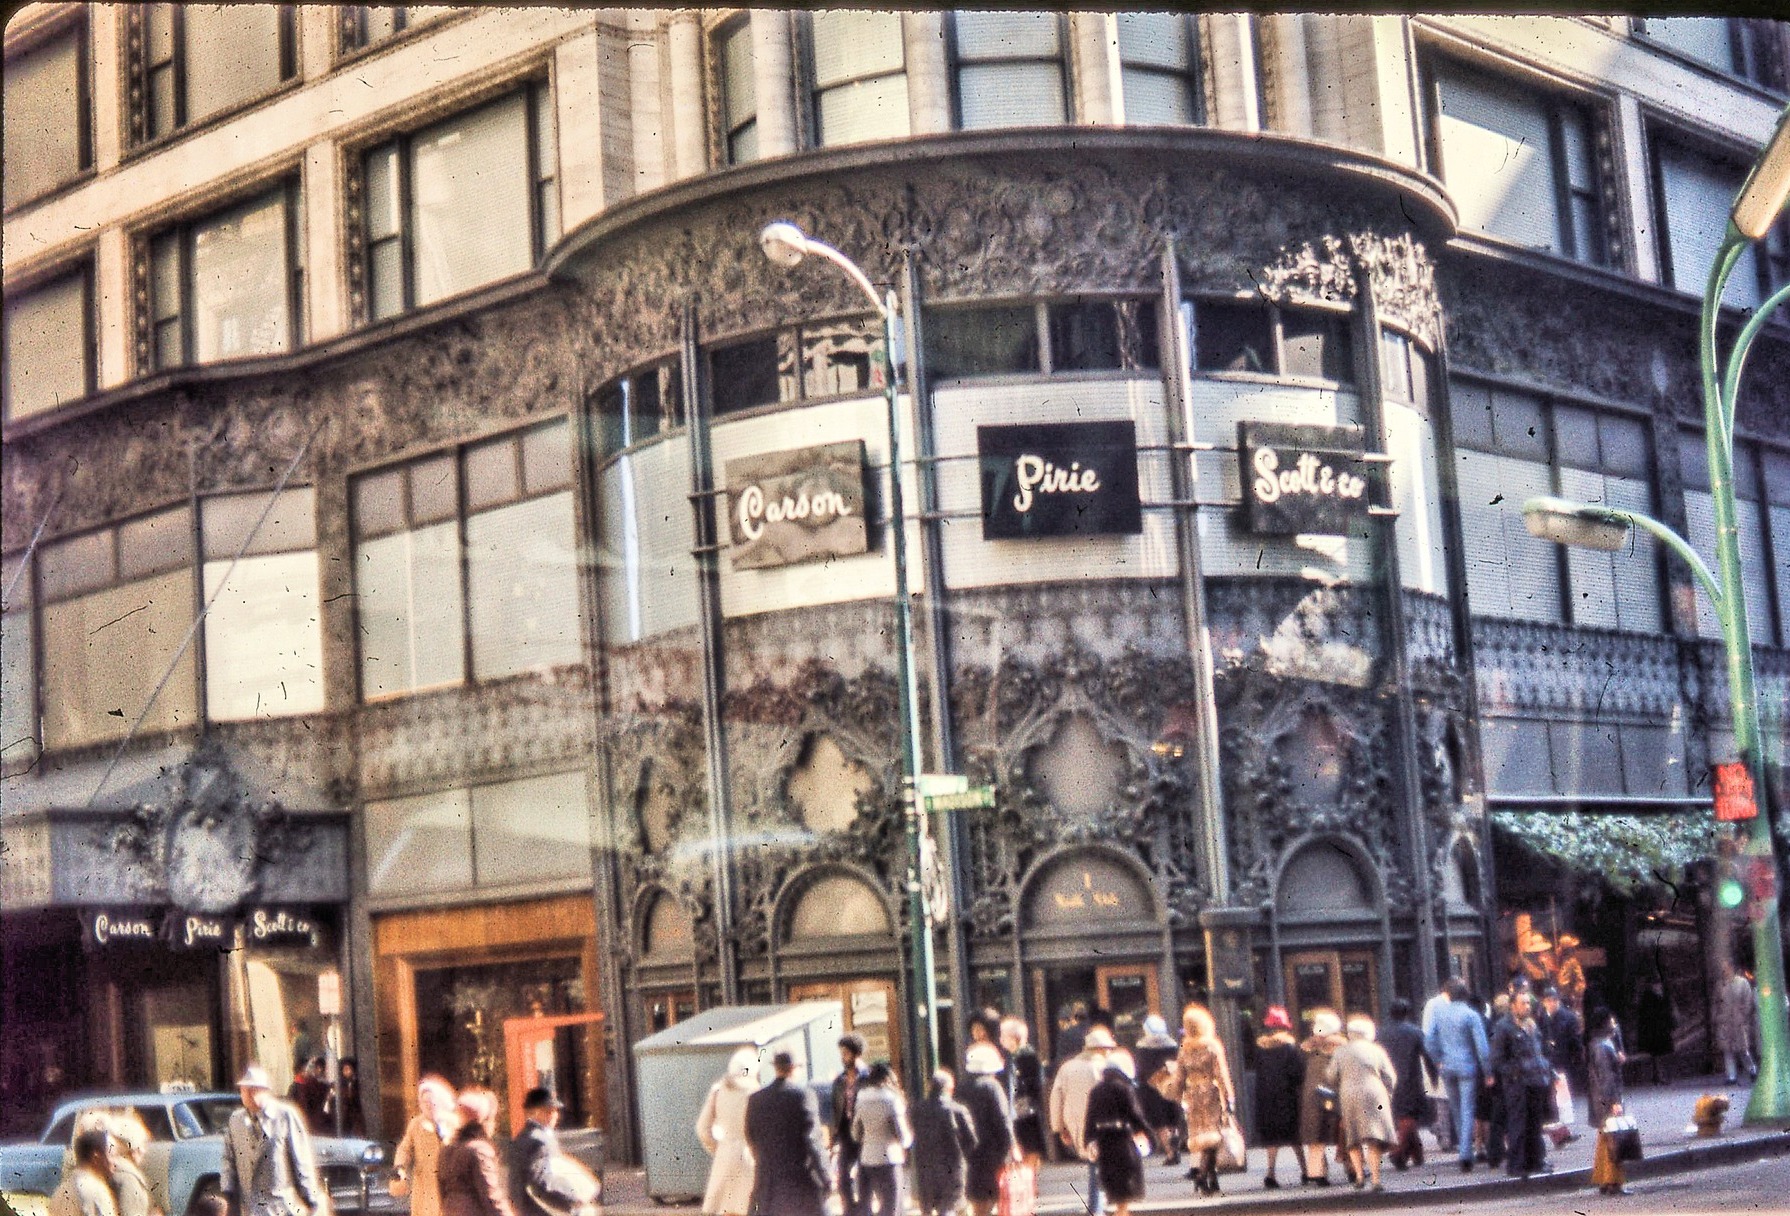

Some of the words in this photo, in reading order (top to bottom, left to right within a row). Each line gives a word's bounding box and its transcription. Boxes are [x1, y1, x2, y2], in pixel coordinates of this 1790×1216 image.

[1013, 453, 1101, 513] Pirie
[739, 485, 852, 541] Carson
[95, 914, 152, 944] Carson
[184, 917, 222, 946] Pirie
